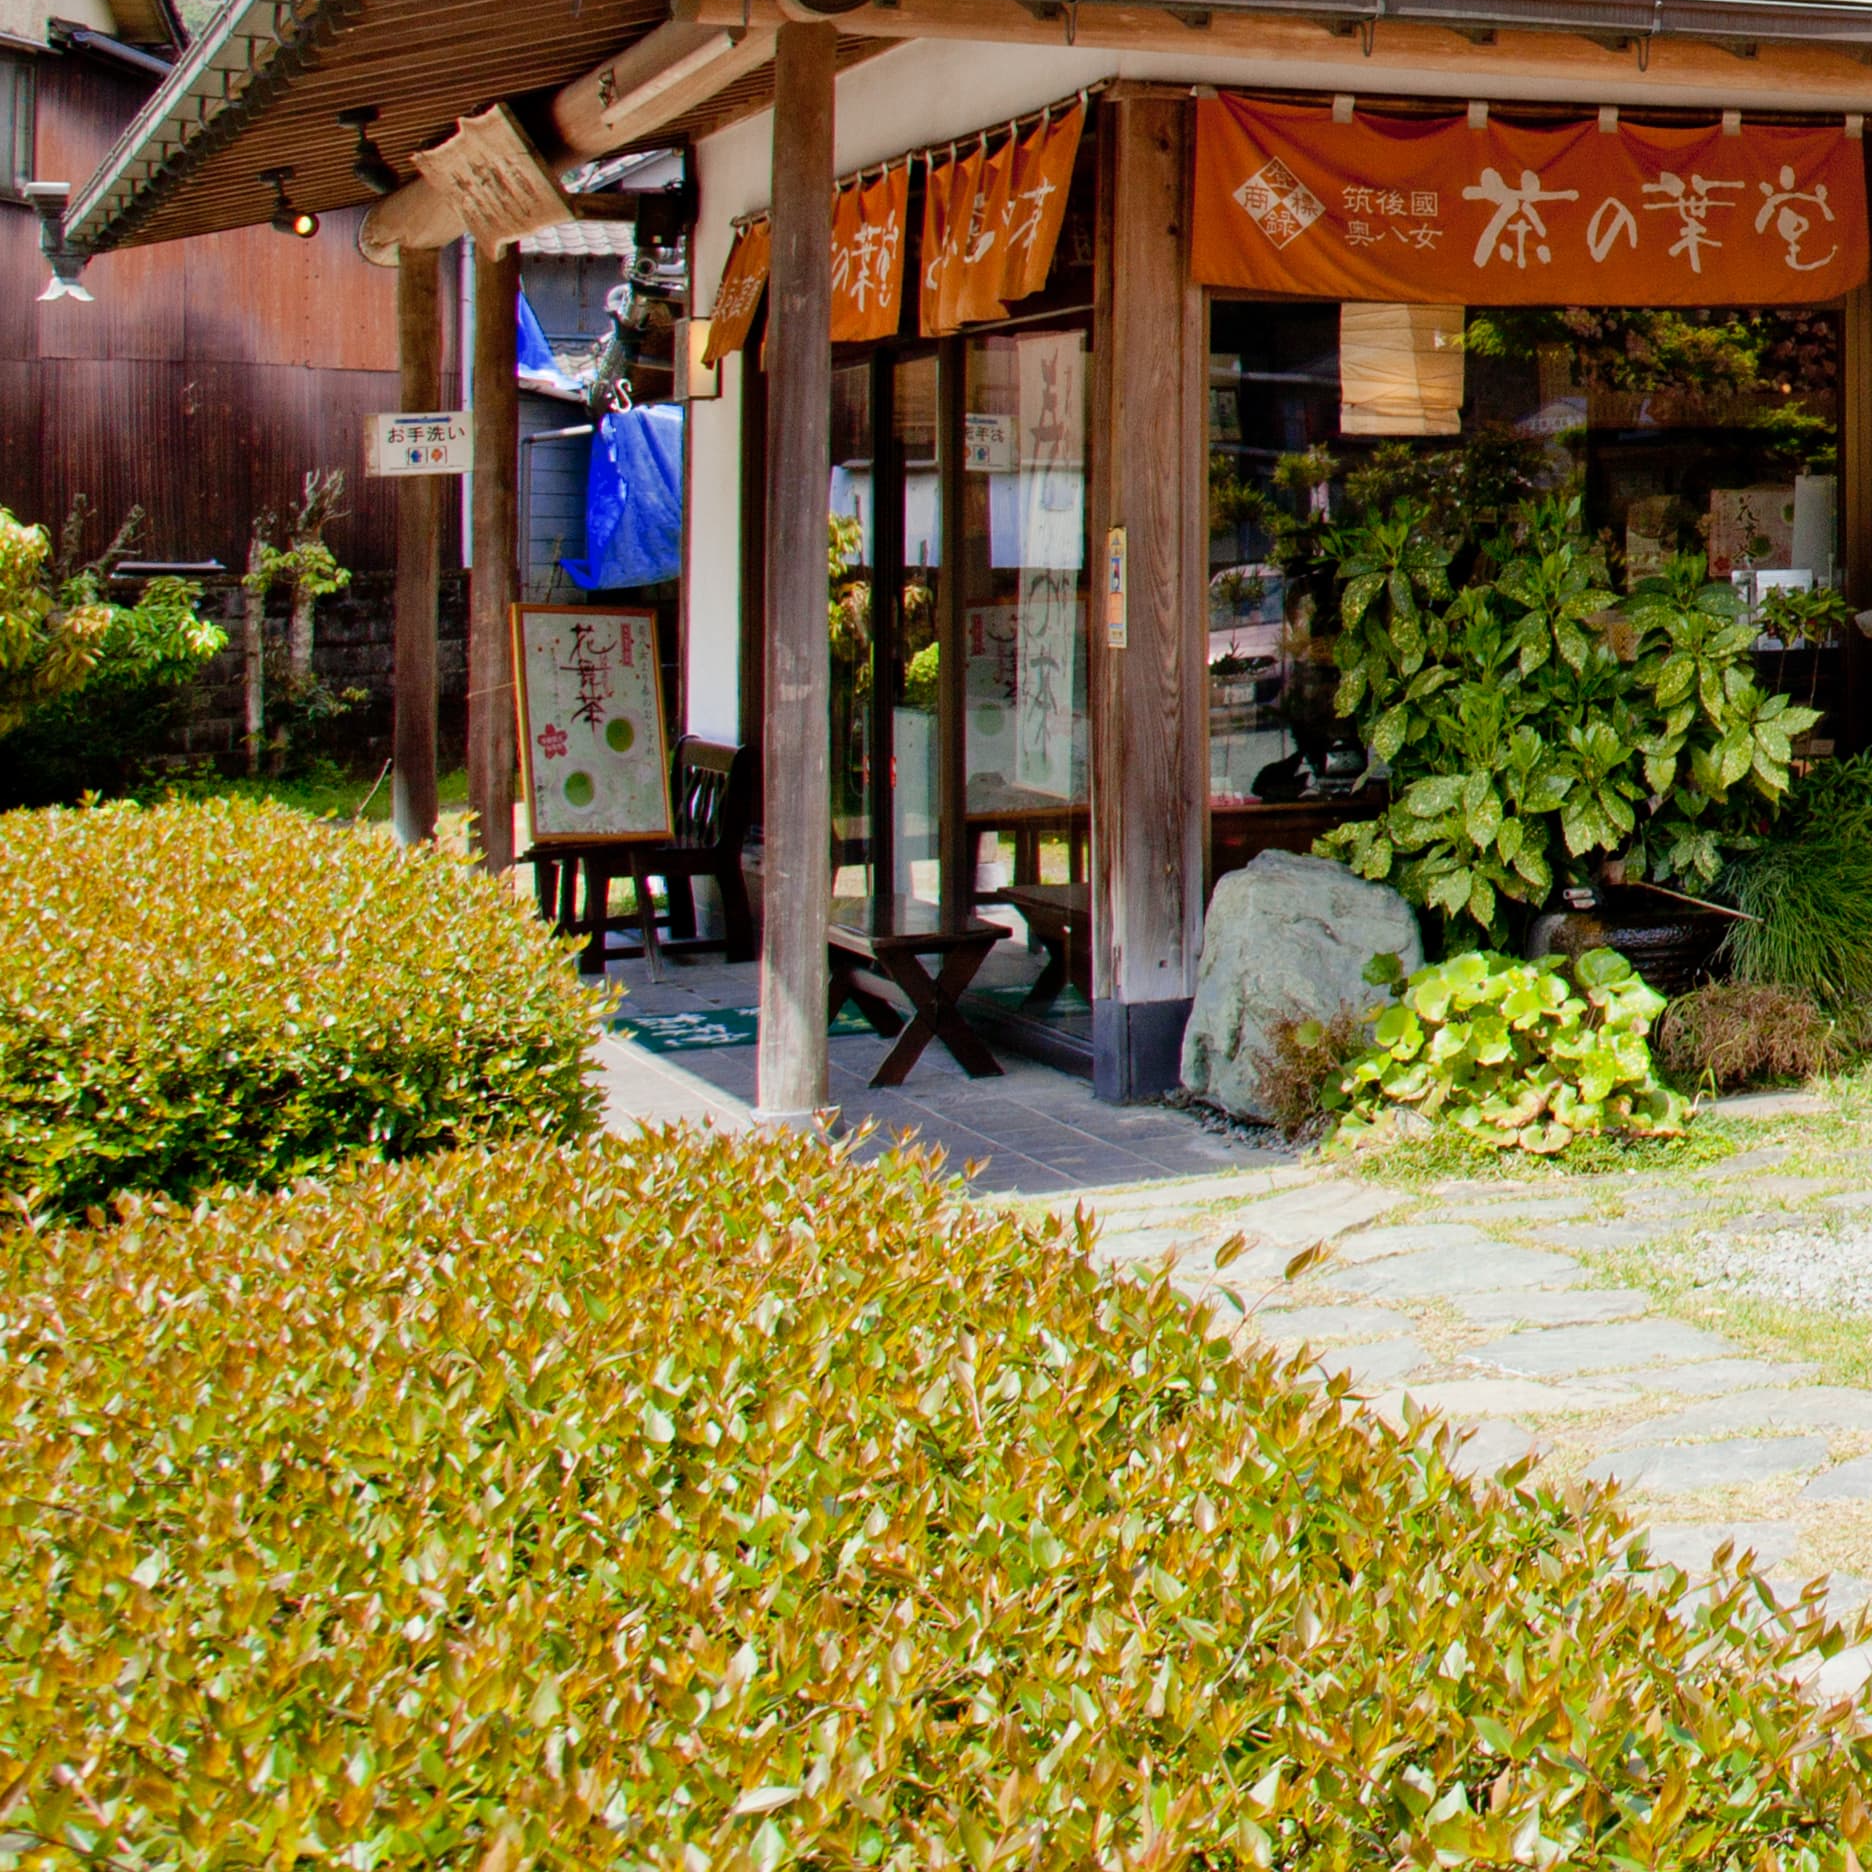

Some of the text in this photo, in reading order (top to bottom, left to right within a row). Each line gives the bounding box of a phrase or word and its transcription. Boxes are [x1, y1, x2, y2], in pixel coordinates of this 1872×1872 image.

[1342, 185, 1438, 217] 筑後國
[1344, 220, 1443, 249] 奥八女
[1462, 166, 1840, 271] 茶の葉堂
[831, 208, 900, 312] の葉堂
[387, 425, 466, 444] お手洗い
